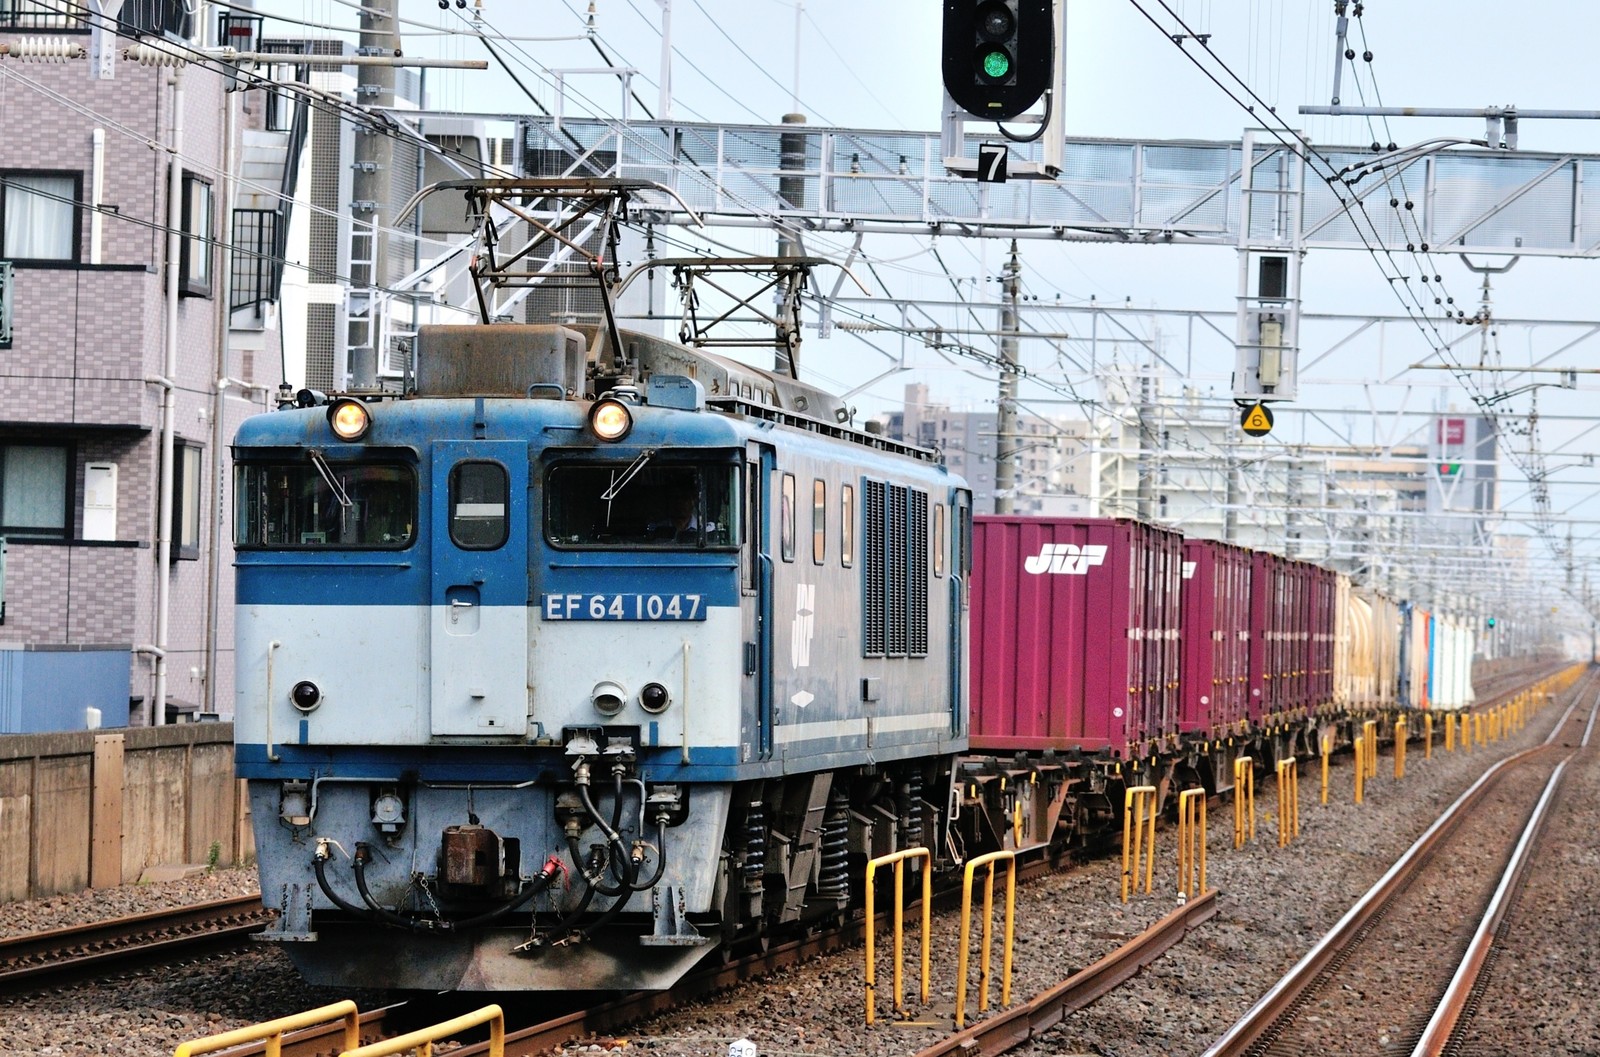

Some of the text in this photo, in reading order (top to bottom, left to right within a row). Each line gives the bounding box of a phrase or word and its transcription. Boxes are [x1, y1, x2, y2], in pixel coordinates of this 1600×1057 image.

[981, 146, 1006, 180] 7
[1252, 414, 1263, 427] 6
[1024, 543, 1108, 575] JRF
[547, 595, 700, 620] EF 64 1047
